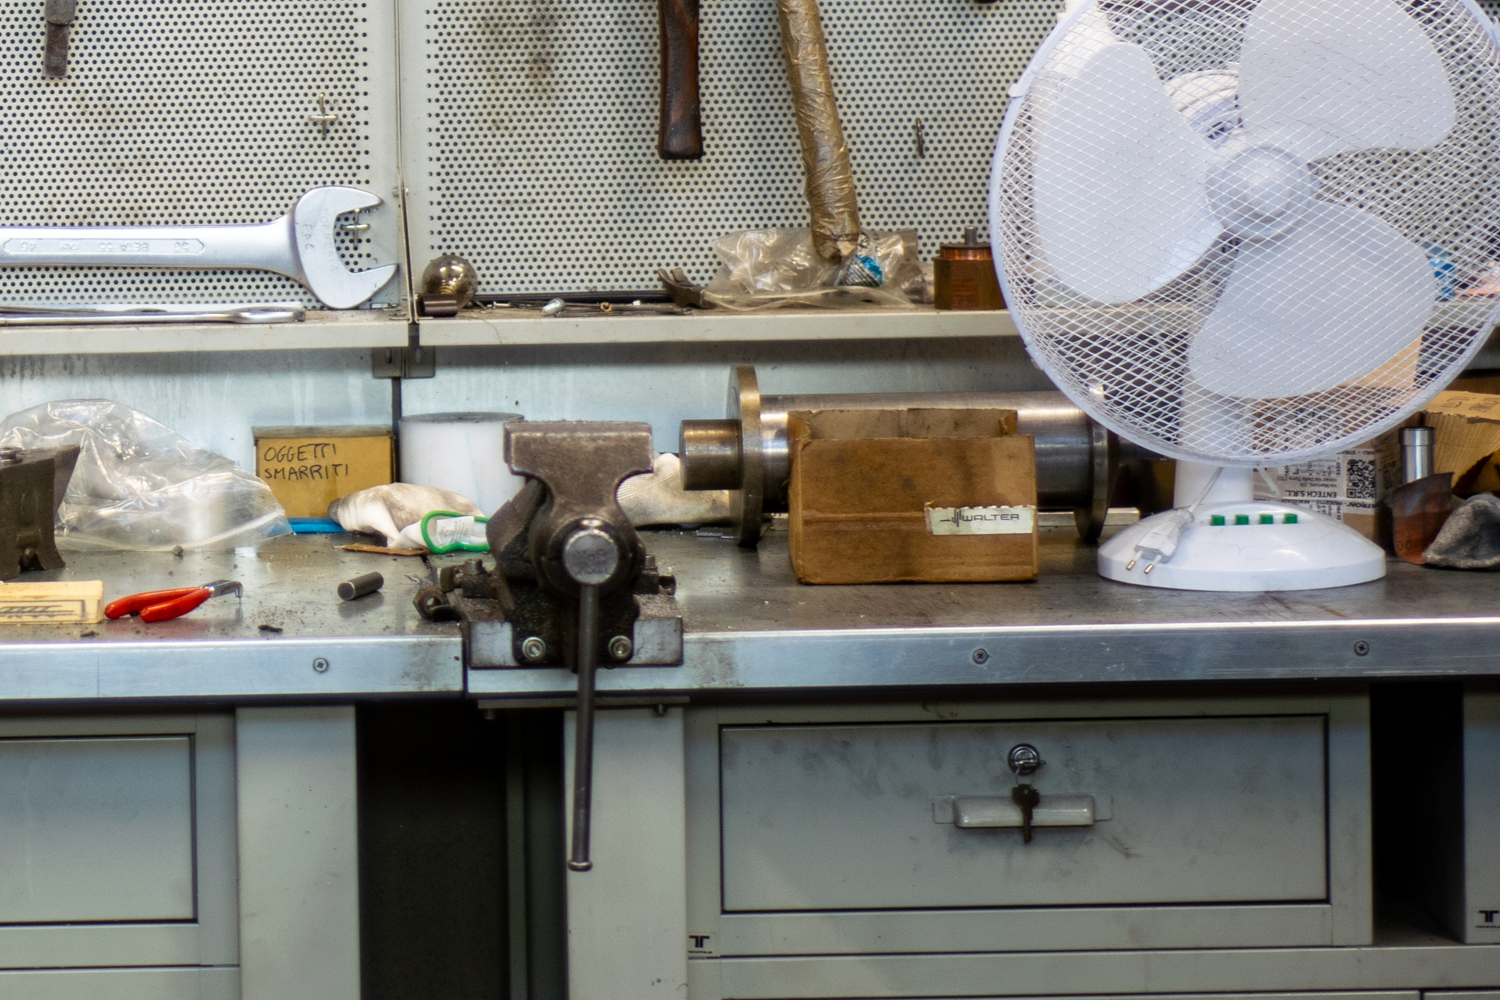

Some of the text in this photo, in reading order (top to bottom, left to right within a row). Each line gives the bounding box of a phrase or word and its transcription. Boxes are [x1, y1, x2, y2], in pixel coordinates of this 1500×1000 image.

[119, 242, 150, 252] BETA
[263, 443, 337, 462] OGGETTI
[264, 464, 349, 481] SMARRITI
[1306, 490, 1337, 498] ENTECH
[961, 513, 1020, 522] WALTER
